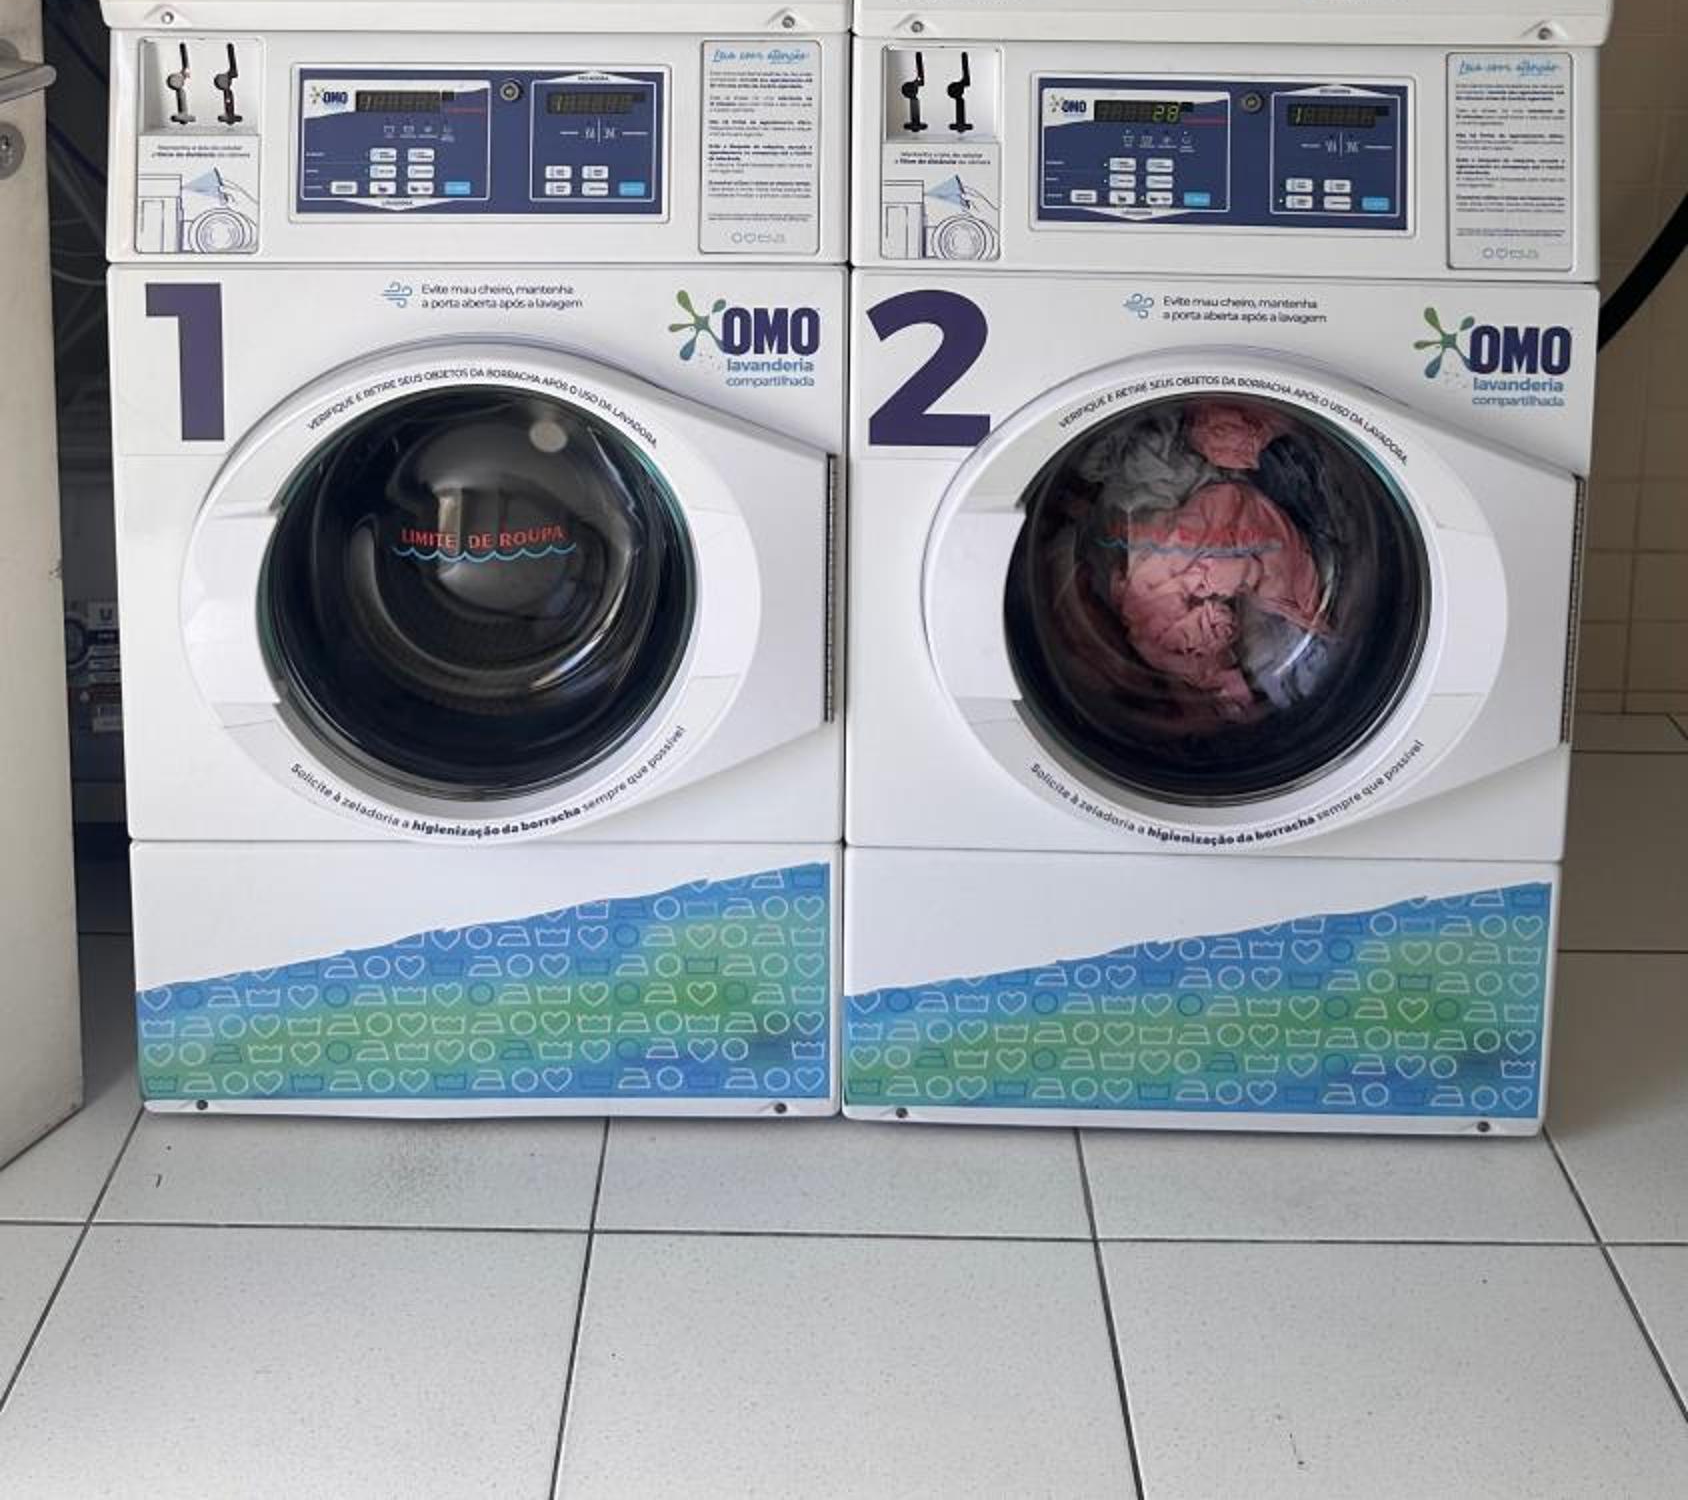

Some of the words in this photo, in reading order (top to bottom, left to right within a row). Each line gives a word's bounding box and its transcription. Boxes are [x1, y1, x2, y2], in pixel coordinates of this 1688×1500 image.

[1152, 104, 1179, 122] 28
[421, 284, 448, 295] Evite
[450, 286, 476, 295] mau
[478, 284, 514, 297] cheiro,
[516, 284, 574, 295] mantenha
[421, 300, 429, 308] a
[431, 299, 460, 311] porta
[461, 298, 497, 309] aberta
[528, 300, 535, 309] a
[536, 298, 583, 311] lavagem
[1163, 295, 1190, 306] Evite
[1192, 297, 1218, 307] mau
[1220, 297, 1257, 309] cheiro,
[1259, 298, 1317, 308] mantenha
[1163, 311, 1170, 319] a
[1171, 310, 1201, 322] porta
[1203, 310, 1239, 320] aberta
[1241, 311, 1269, 324] após
[1270, 313, 1277, 322] a
[1278, 312, 1327, 325] lavagem
[722, 307, 821, 356] OMO
[1469, 325, 1572, 376] OMO
[145, 282, 225, 441] 1
[727, 358, 814, 372] lavanderia
[866, 289, 991, 447] 2
[726, 375, 815, 388] compartilhada
[1473, 377, 1564, 392] lavanderia
[307, 397, 354, 430] VERIFIQUE
[355, 391, 363, 402] E
[398, 374, 423, 387] SEUS
[423, 368, 468, 381] OBJETOS
[470, 368, 485, 378] DA
[486, 368, 540, 384] BORRACHA
[569, 385, 578, 394] O
[578, 388, 599, 403] USO
[599, 399, 612, 412] DA
[1059, 396, 1106, 428] VERIFIQUE
[1107, 391, 1114, 402] E
[1149, 377, 1175, 390] SEUS
[1175, 375, 1220, 387] OBJETOS
[1221, 375, 1236, 387] DA
[1237, 377, 1292, 394] BORRACHA
[1320, 397, 1329, 407] O
[1329, 401, 1350, 417] USO
[1350, 412, 1364, 426] DA
[1472, 395, 1565, 408] compartilhada
[400, 528, 457, 549] LIMITE
[468, 533, 494, 549] DE
[499, 525, 567, 548] ROUPA
[291, 763, 333, 796] Solicite
[341, 797, 399, 827] zeladoria
[401, 819, 409, 828] a
[411, 819, 500, 839] higienização
[502, 824, 519, 835] da
[521, 806, 581, 832] borracha
[582, 782, 627, 812] sempre
[627, 764, 649, 787] que
[650, 725, 686, 769] possível
[1030, 763, 1070, 799] Solicite
[1079, 800, 1135, 831] zeladoria
[1137, 826, 1145, 835] a
[1147, 825, 1235, 847] higienização
[1236, 832, 1253, 844] da
[1255, 815, 1316, 841] borracha
[1316, 792, 1362, 821] sempre
[1362, 775, 1385, 797] que
[1384, 739, 1425, 782] possível
